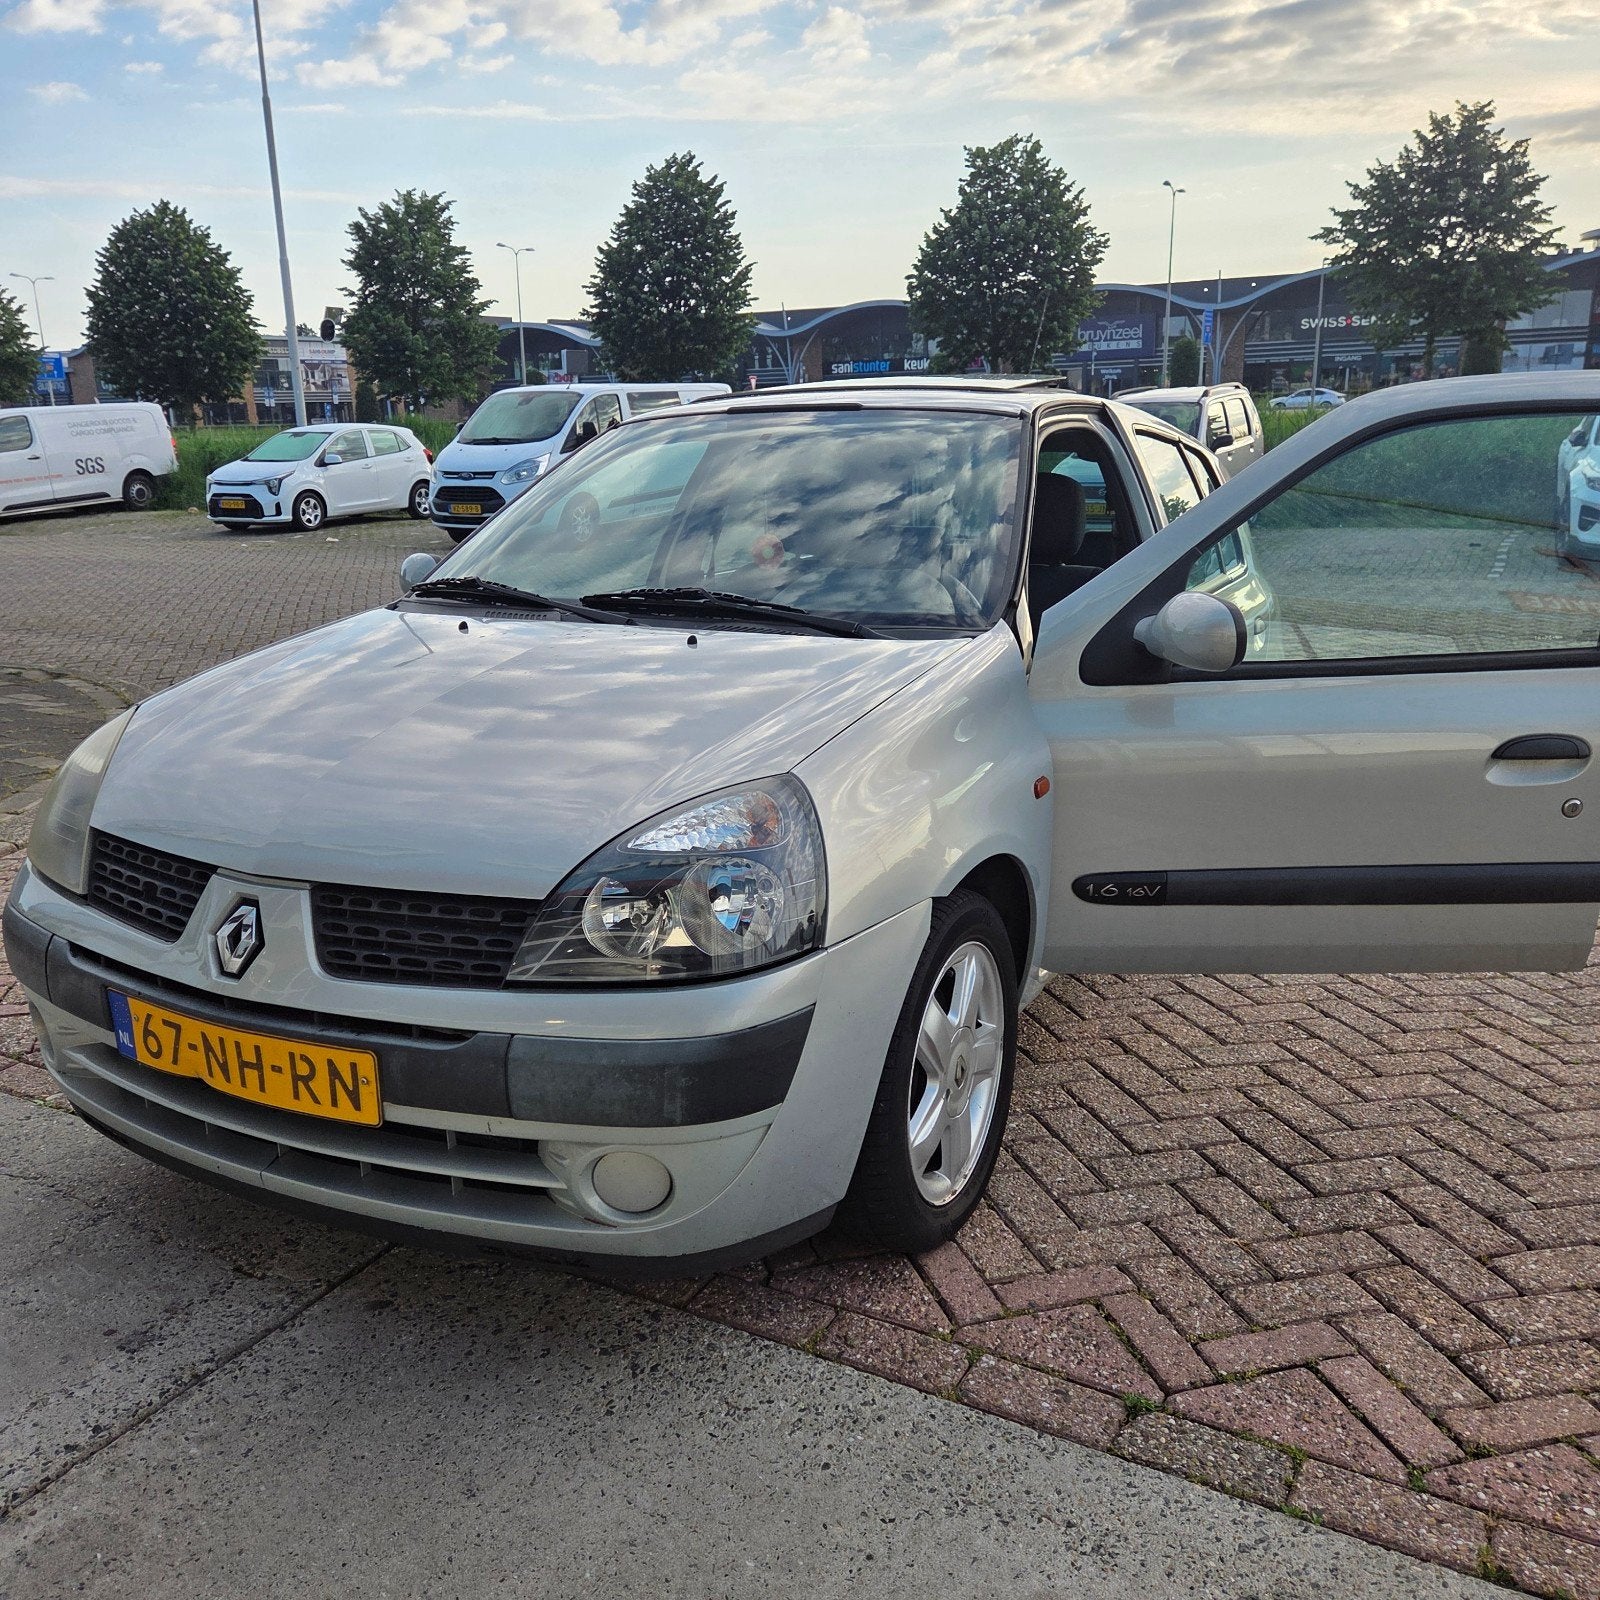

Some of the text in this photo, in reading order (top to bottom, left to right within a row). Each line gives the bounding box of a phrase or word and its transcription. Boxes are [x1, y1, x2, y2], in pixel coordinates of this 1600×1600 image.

[1301, 316, 1346, 329] SWISS
[1078, 324, 1143, 342] bruynzeel
[1080, 341, 1142, 350] EUKENS
[831, 360, 890, 374] sanistunter
[904, 357, 931, 371] keuk
[75, 456, 105, 475] SGS
[1086, 883, 1161, 897] 1.6 16V
[119, 1029, 134, 1048] NL
[142, 1012, 361, 1112] 67-NH-RN
